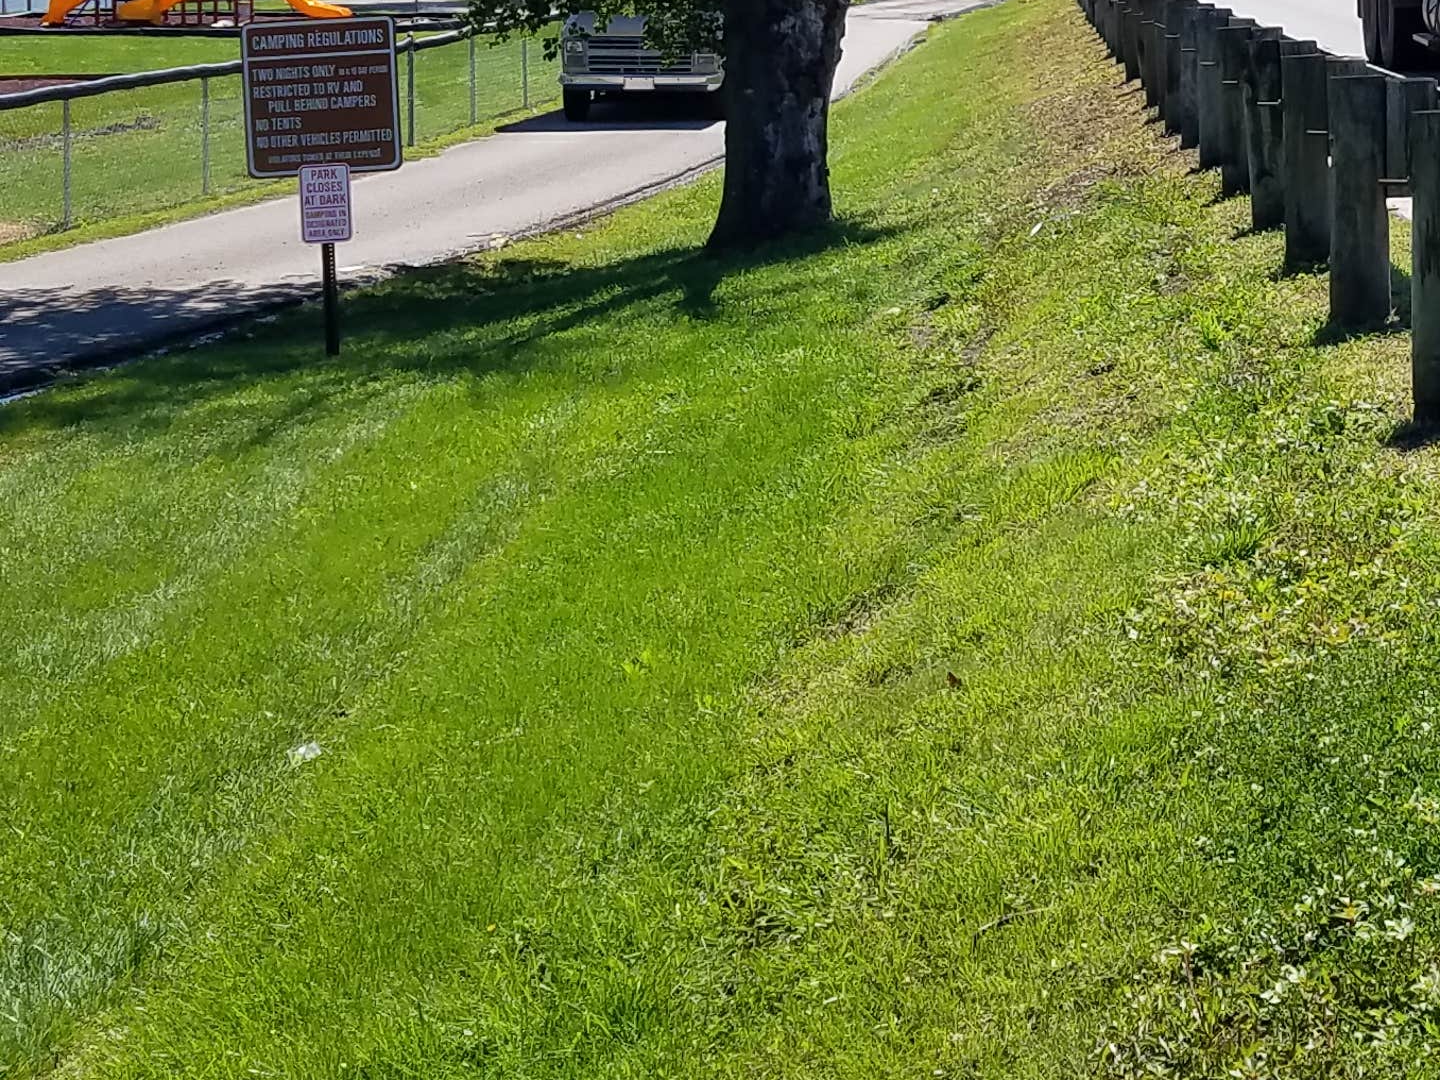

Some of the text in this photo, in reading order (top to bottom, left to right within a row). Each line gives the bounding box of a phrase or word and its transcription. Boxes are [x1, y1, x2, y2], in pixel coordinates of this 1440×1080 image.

[252, 28, 384, 50] CAMPING REGULATIONS
[252, 68, 273, 81] TWO
[276, 66, 310, 80] NIGHTS
[312, 64, 336, 77] ONLY
[253, 80, 363, 98] RESTRICTED TO RV AND
[268, 94, 376, 113] PULL BEHIND CAMPERS
[255, 117, 302, 131] NO TENTS
[256, 128, 392, 148] NO OTHER VEHICLES PERMITTED
[311, 168, 338, 181] PARK
[306, 181, 342, 193] CLOSES
[305, 193, 346, 206] AT DARK
